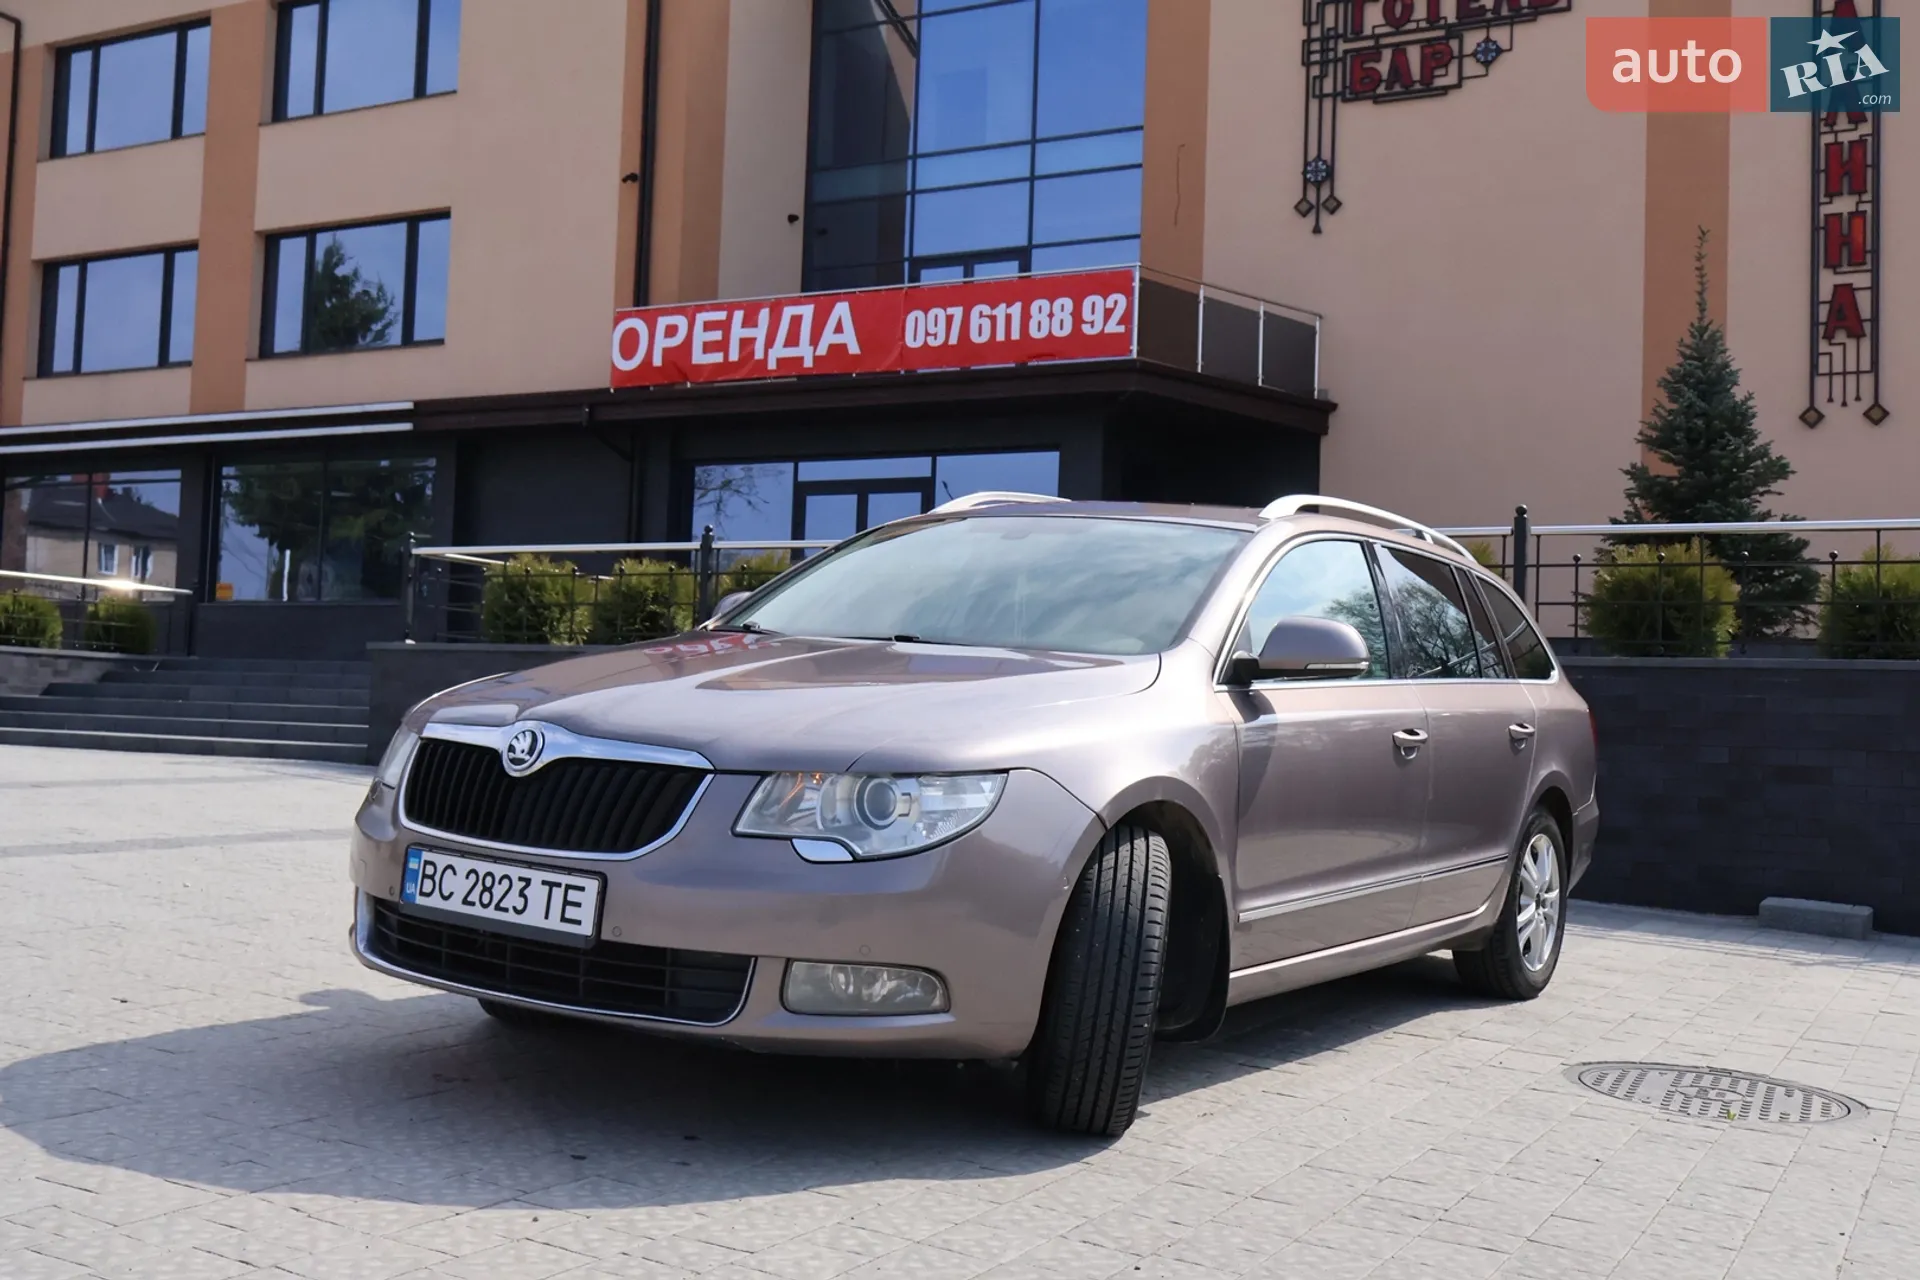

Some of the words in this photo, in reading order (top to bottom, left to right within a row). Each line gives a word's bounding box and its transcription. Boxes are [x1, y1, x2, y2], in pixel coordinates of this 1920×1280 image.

[1350, 0, 1558, 36] ГОТ
[1351, 42, 1453, 93] БАР
[611, 300, 861, 371] ОРЕНДА
[905, 307, 963, 349] 097
[969, 301, 1023, 345] 611
[1028, 295, 1074, 339] 88
[1080, 292, 1128, 336] 92
[418, 859, 457, 901] BC
[461, 868, 532, 915] 2823
[541, 879, 586, 926] TE
